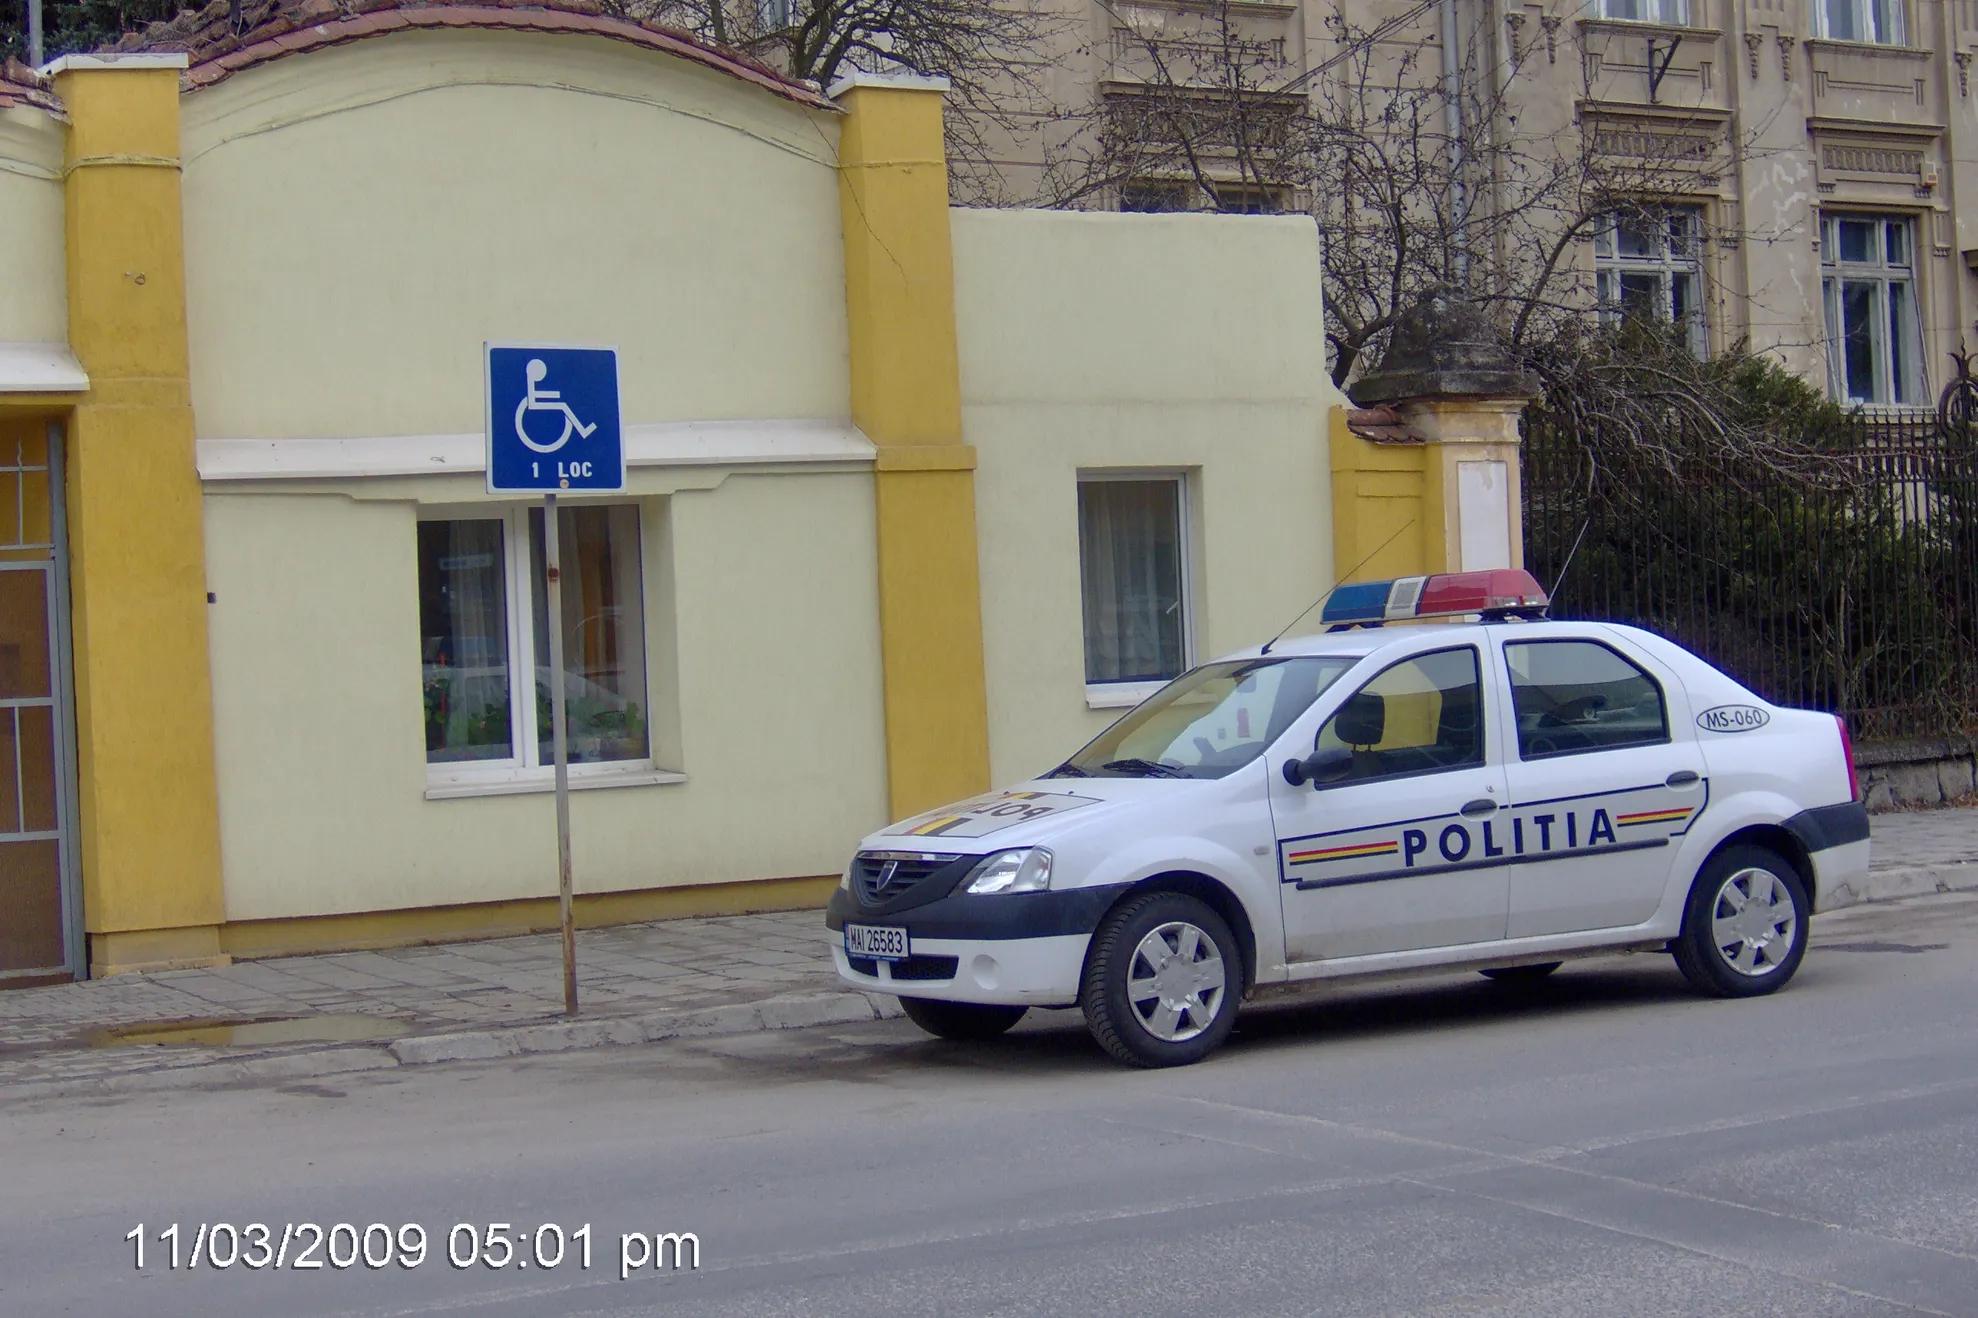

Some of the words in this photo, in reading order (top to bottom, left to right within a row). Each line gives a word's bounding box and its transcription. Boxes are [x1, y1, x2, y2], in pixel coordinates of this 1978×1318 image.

[531, 461, 539, 479] 1
[557, 461, 593, 478] LOC
[1706, 709, 1763, 728] MS-060
[1403, 808, 1617, 867] POLITIA
[850, 927, 865, 951] MAI
[867, 929, 903, 954] 26583
